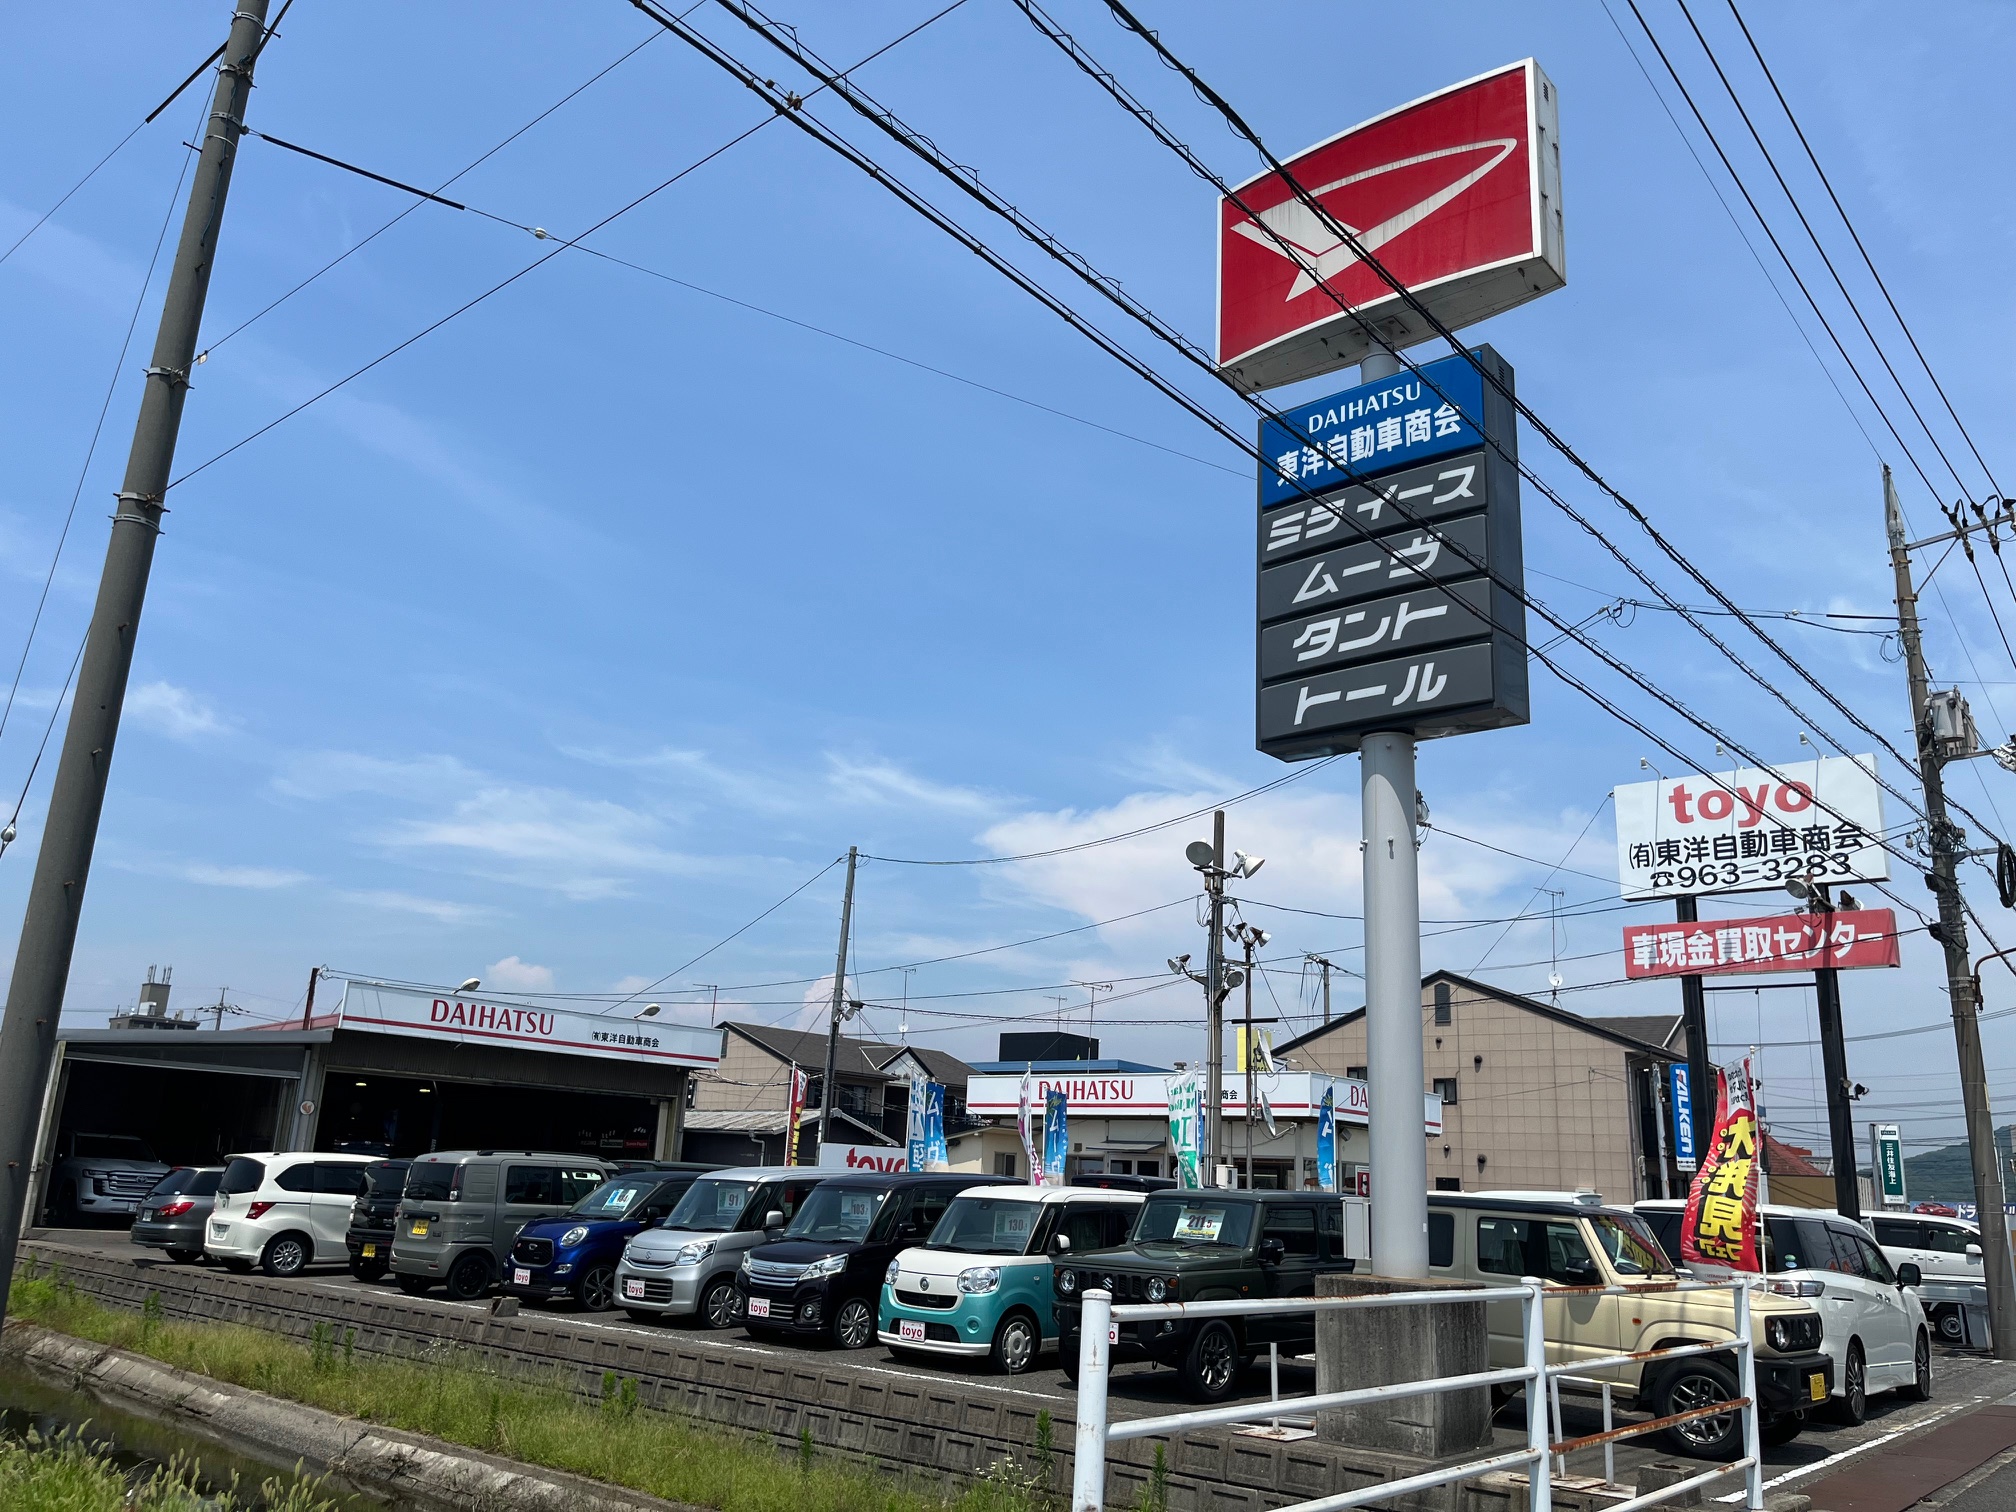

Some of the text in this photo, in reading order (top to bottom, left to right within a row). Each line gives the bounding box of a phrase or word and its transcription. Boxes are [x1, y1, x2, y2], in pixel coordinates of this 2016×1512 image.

[1308, 381, 1421, 434] DAIHATSU
[1276, 405, 1462, 488] 東洋自動車商会
[1292, 532, 1442, 604] ムーヴ
[1292, 602, 1448, 662] タント
[1293, 662, 1448, 725] トール
[1668, 780, 1813, 828] toyo
[1677, 853, 1852, 888] 963-3283
[1632, 921, 1883, 970] 車現金買取センター
[430, 998, 555, 1036] DAIHATSU
[1038, 1080, 1134, 1101] DAIHATSU
[1675, 1068, 1693, 1154] FALKEN
[926, 1091, 940, 1168] ムーヴ
[1886, 1142, 1897, 1185] 三井住友海上
[515, 1272, 529, 1284] toyo
[628, 1284, 644, 1296] toyo
[750, 1300, 769, 1315] toyo
[902, 1325, 923, 1339] toyo
